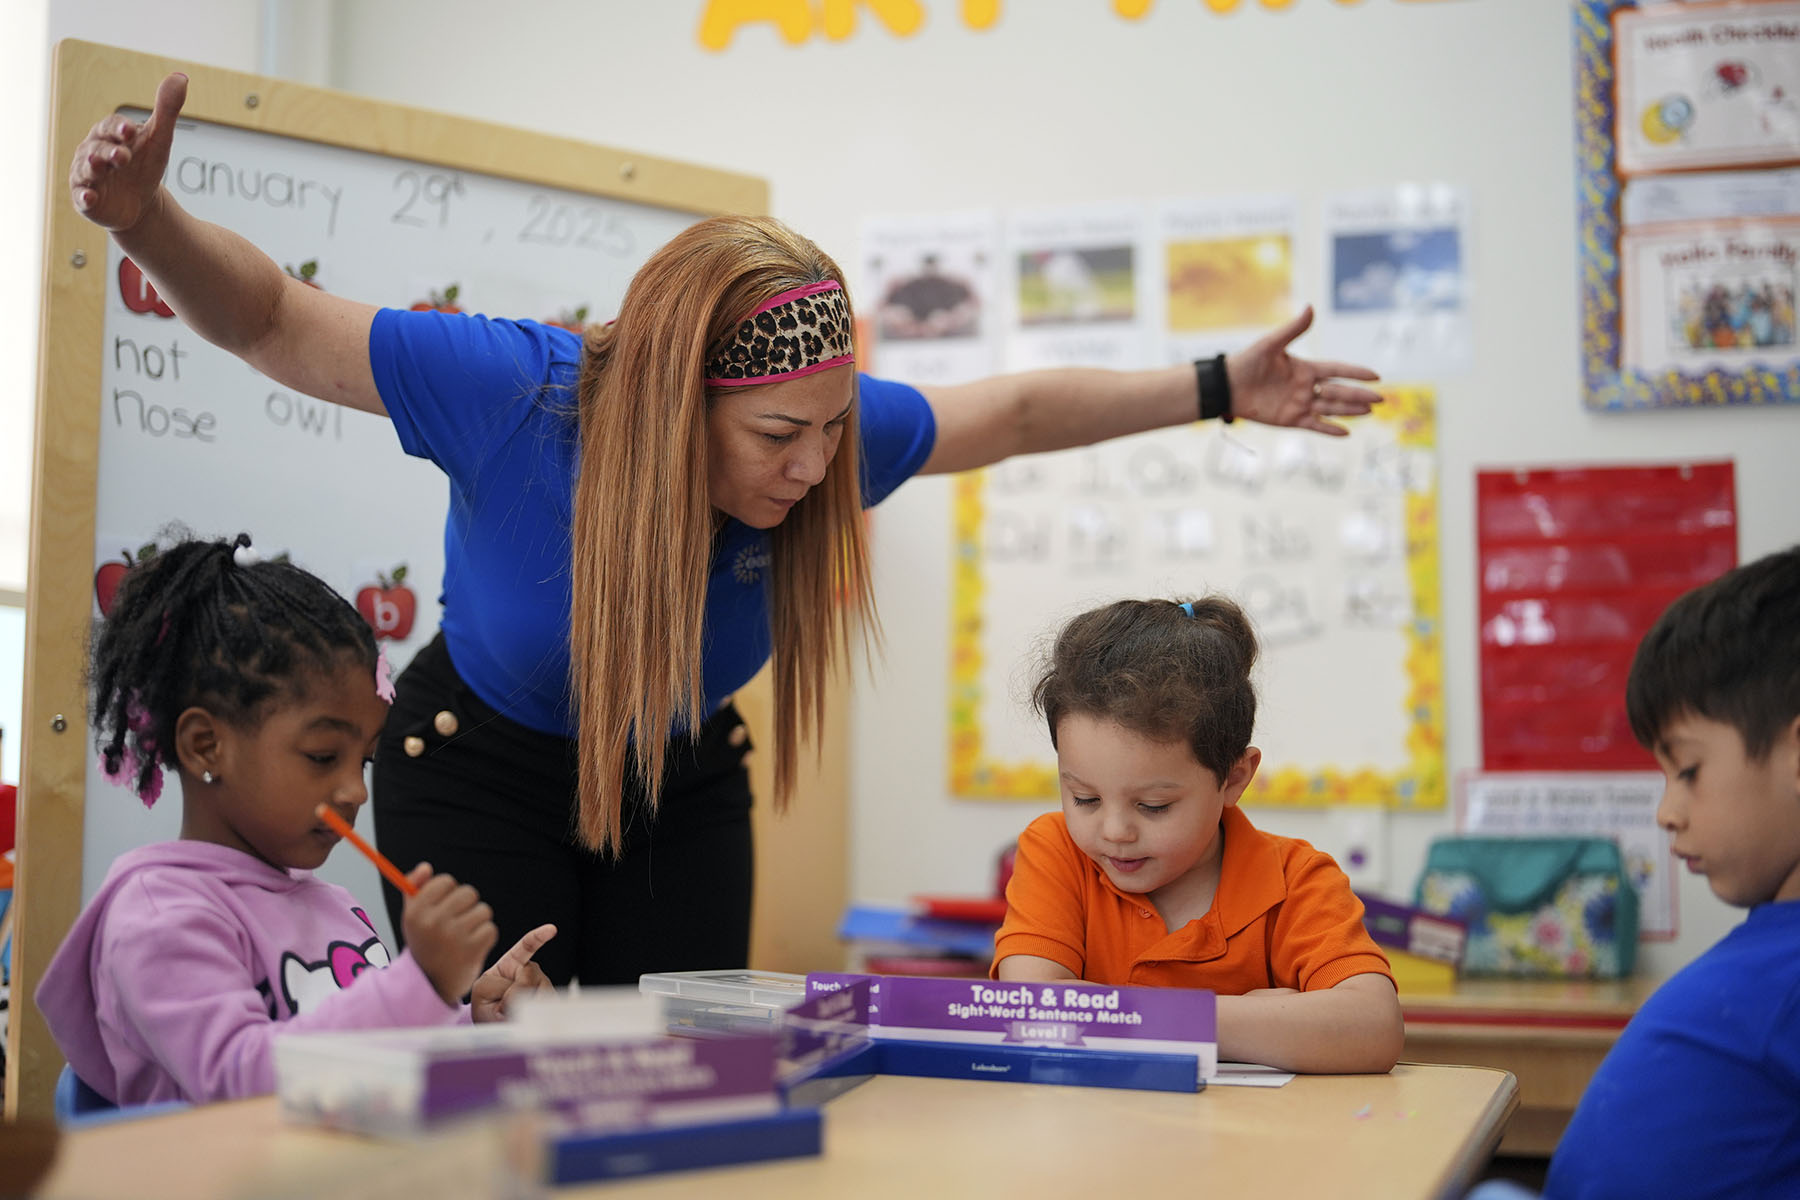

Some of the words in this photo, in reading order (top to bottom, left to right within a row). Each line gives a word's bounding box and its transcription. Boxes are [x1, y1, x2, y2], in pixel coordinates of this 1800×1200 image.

[163, 155, 344, 240] anuary
[517, 192, 637, 260] 2025
[115, 334, 188, 382] not
[264, 391, 343, 440] owl
[372, 591, 402, 630] b
[811, 980, 842, 992] Touch
[970, 984, 1034, 1006] Touch
[1040, 987, 1058, 1007] &
[1063, 988, 1119, 1010] Read
[947, 1002, 1026, 1020] Sight-Word
[1028, 1006, 1094, 1023] Sentence
[1096, 1010, 1143, 1025] Match
[1020, 1024, 1058, 1040] Level
